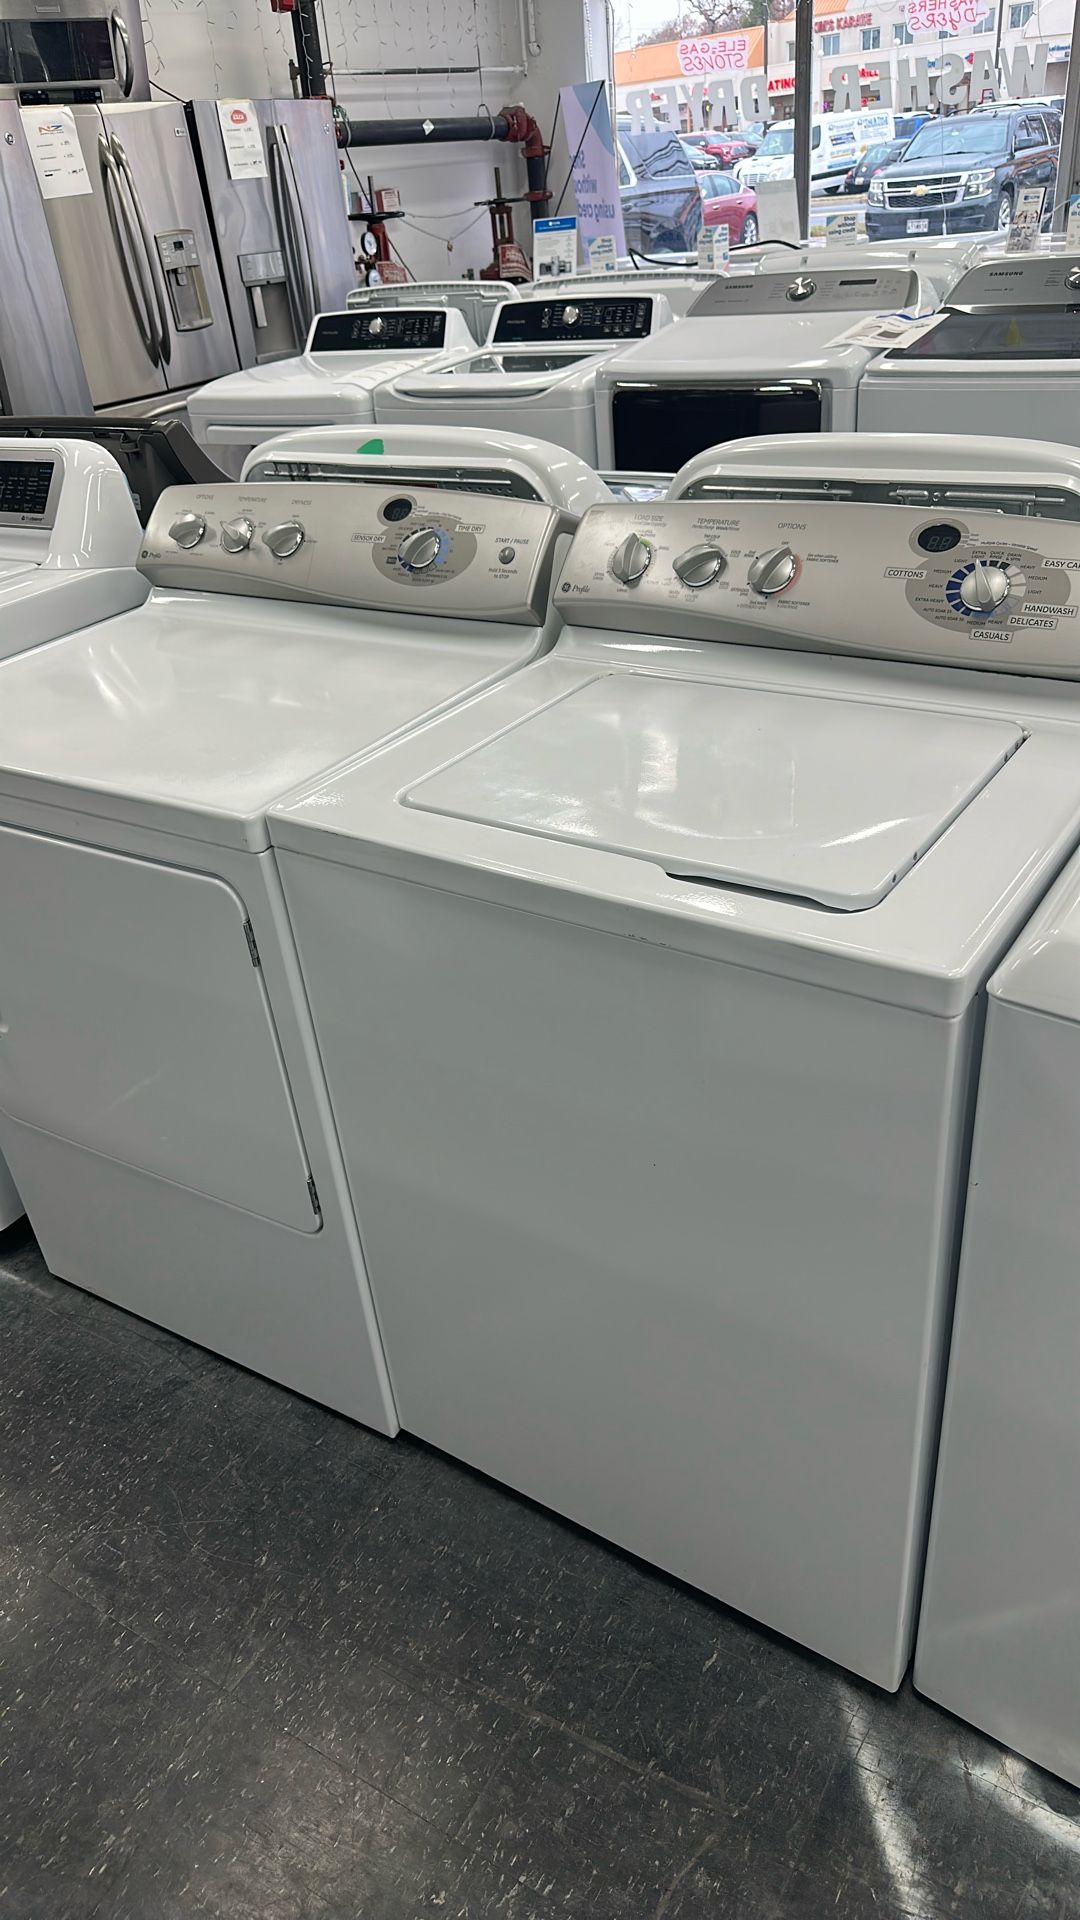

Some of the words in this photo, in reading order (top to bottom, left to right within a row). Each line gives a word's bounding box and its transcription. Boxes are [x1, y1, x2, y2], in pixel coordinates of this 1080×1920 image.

[697, 517, 741, 526] TEMPERATURE
[777, 522, 807, 530] OPTIONS
[1044, 560, 1065, 568] EASY
[887, 569, 924, 578] COTTONS
[572, 584, 590, 594] Profile
[1024, 604, 1075, 616] HANDWASH
[1010, 617, 1054, 628] DELICATES
[973, 631, 1010, 641] CASUALS
